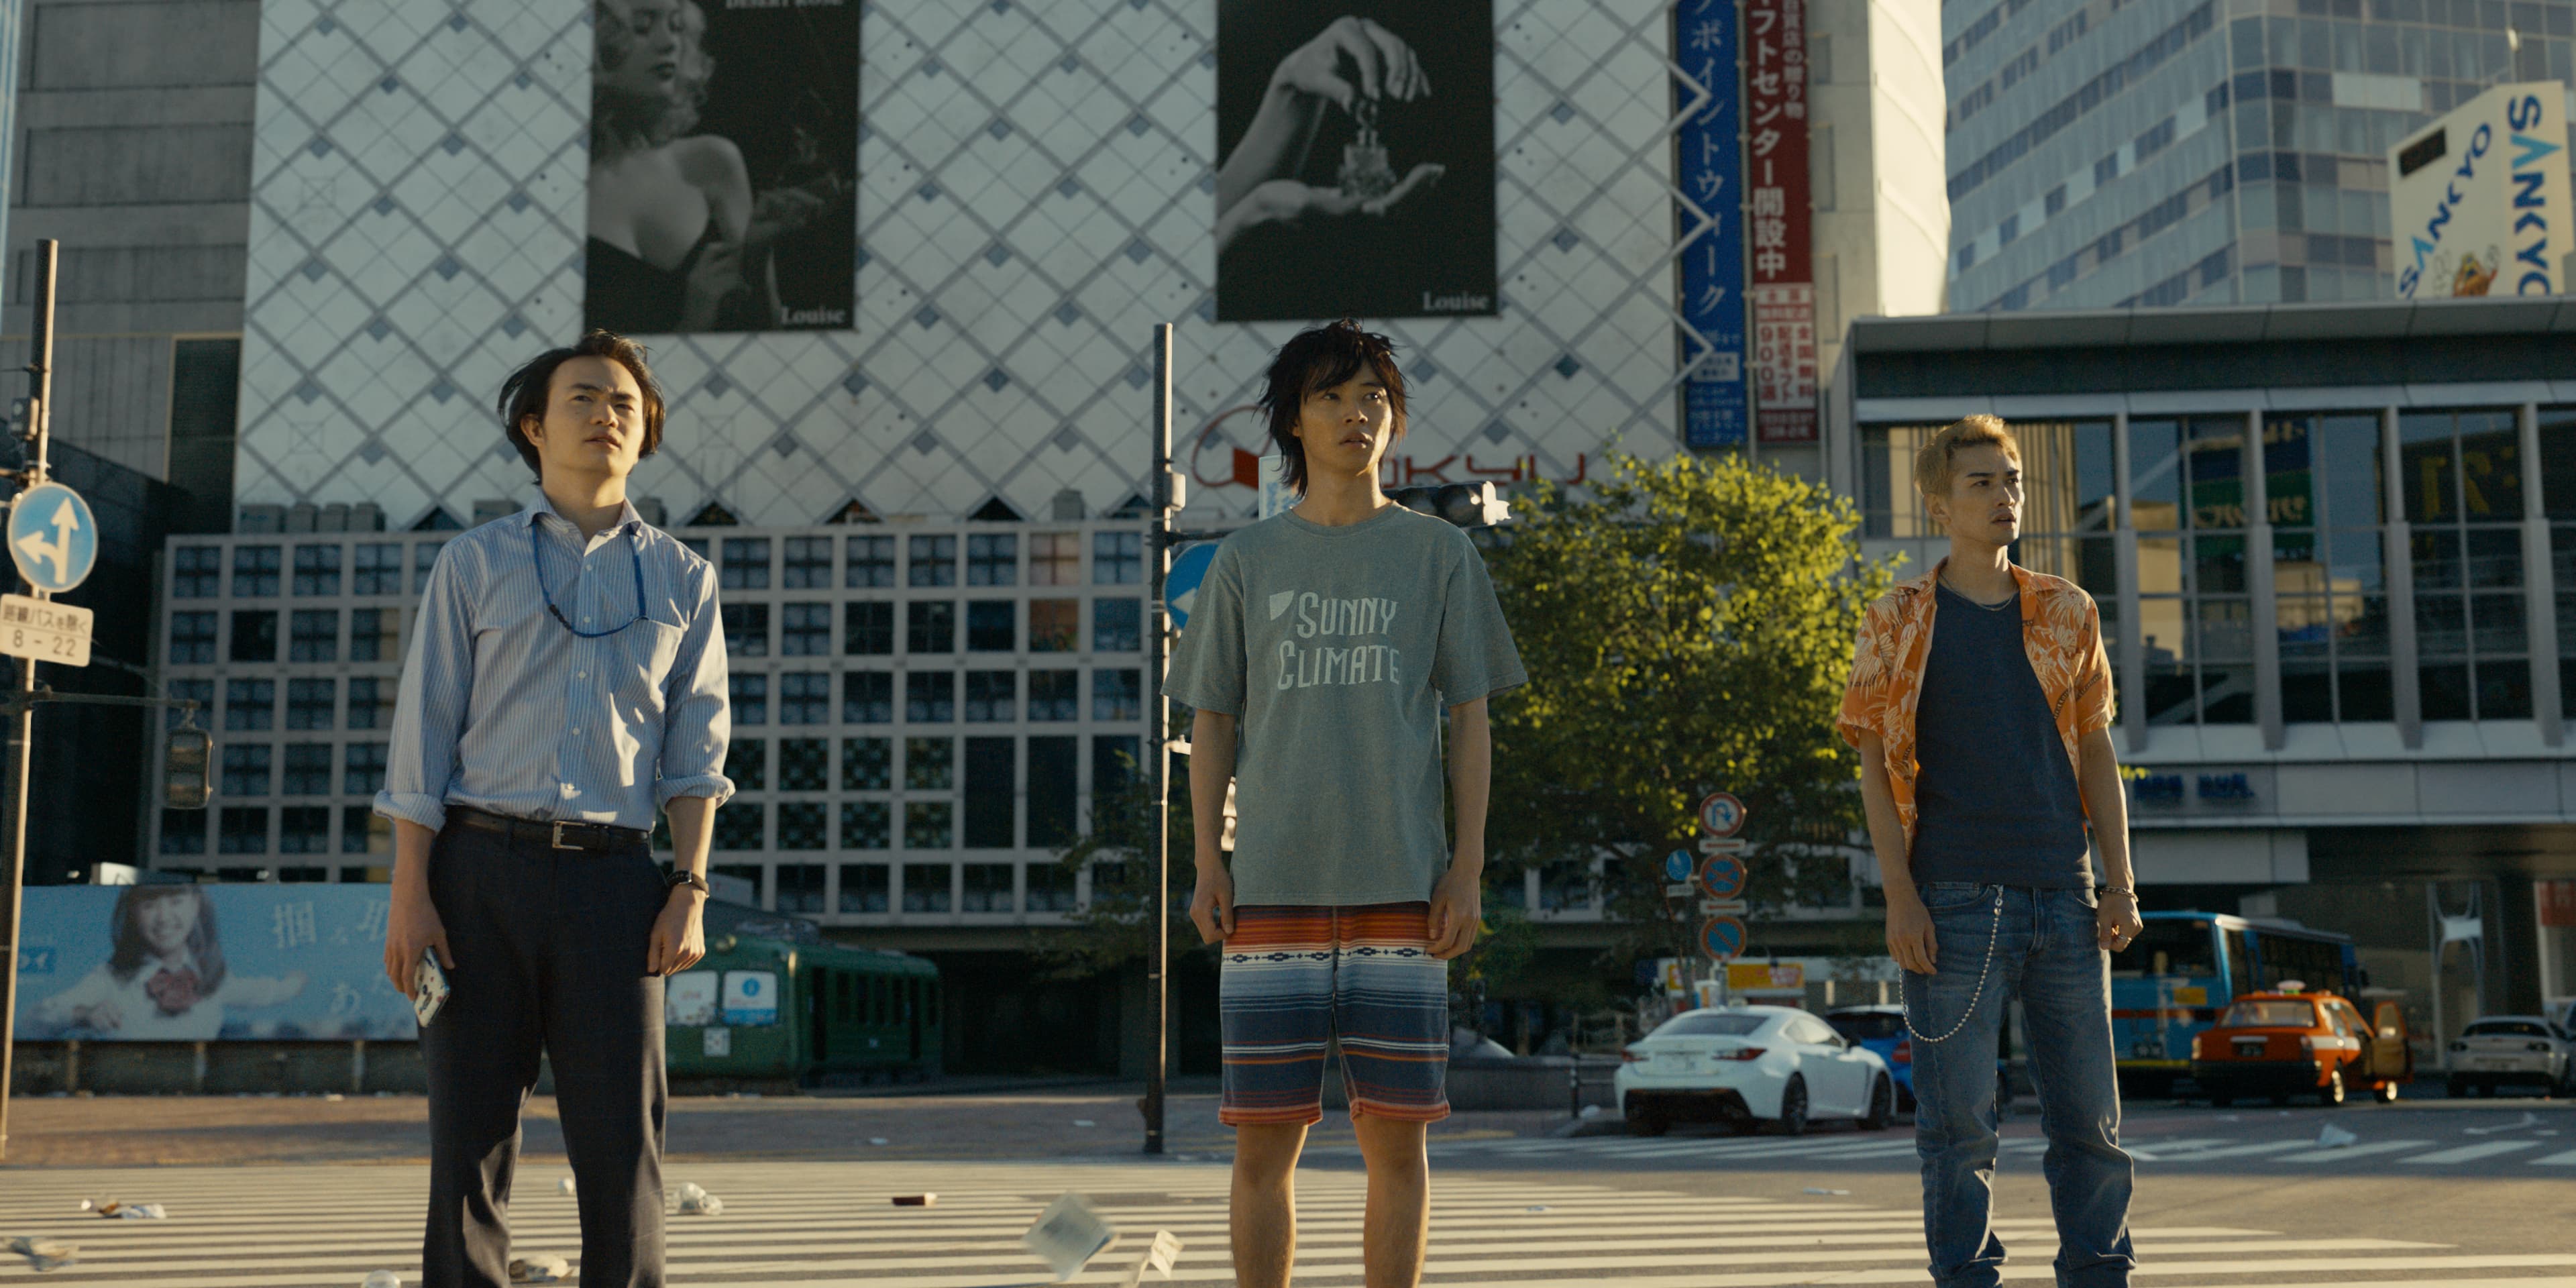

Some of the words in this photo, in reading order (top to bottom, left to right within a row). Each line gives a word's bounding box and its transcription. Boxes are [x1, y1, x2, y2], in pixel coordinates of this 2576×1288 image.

[1750, 0, 1786, 280] フトセンター開設中
[782, 306, 847, 325] Louise
[1422, 291, 1490, 311] Louise
[1295, 592, 1399, 639] SUNNY
[1277, 639, 1401, 691] CLIMATE
